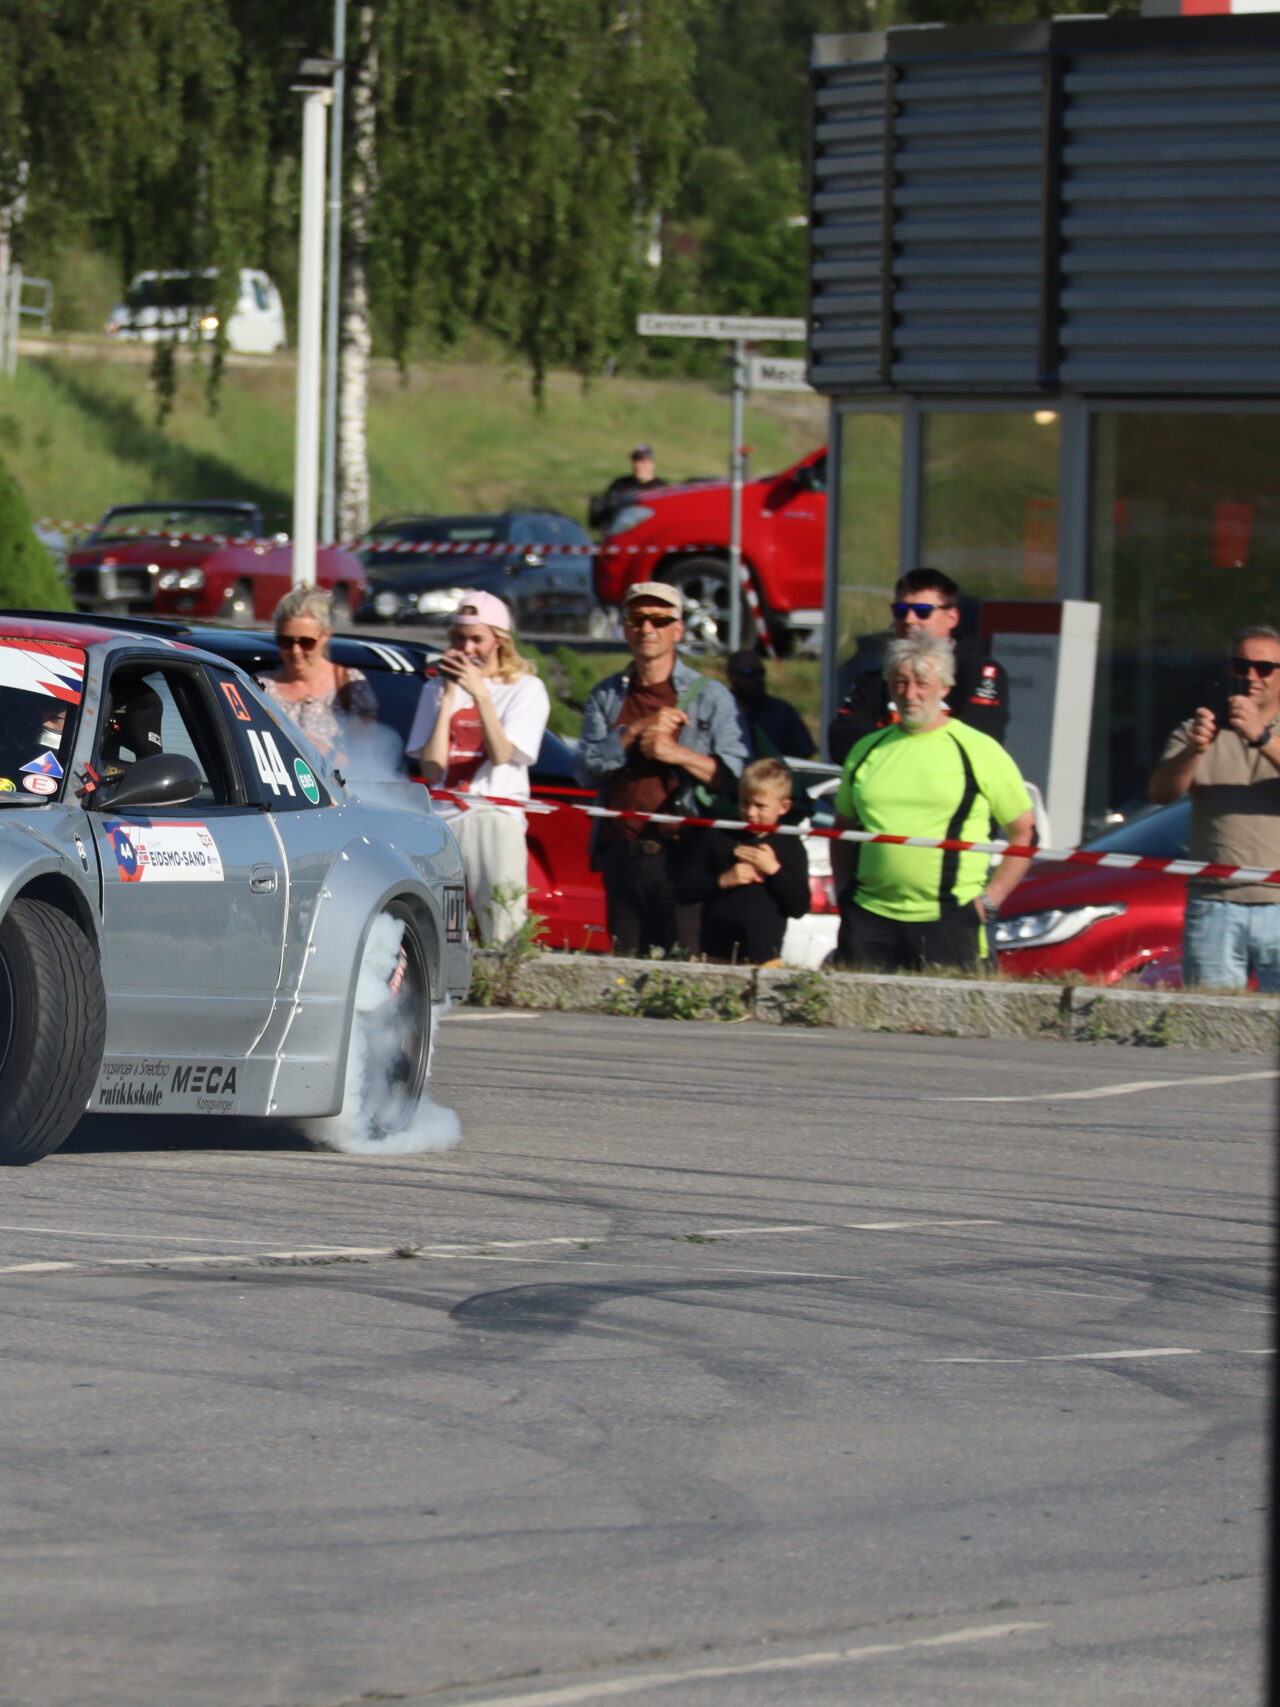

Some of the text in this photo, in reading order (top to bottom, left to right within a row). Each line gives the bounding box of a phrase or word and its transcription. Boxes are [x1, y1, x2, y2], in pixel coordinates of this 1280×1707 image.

[247, 729, 296, 797] 44
[121, 843, 132, 859] 44
[150, 851, 206, 866] EIDSMO-SAND
[170, 1065, 237, 1094] MECA
[99, 1083, 162, 1106] rafikkskole
